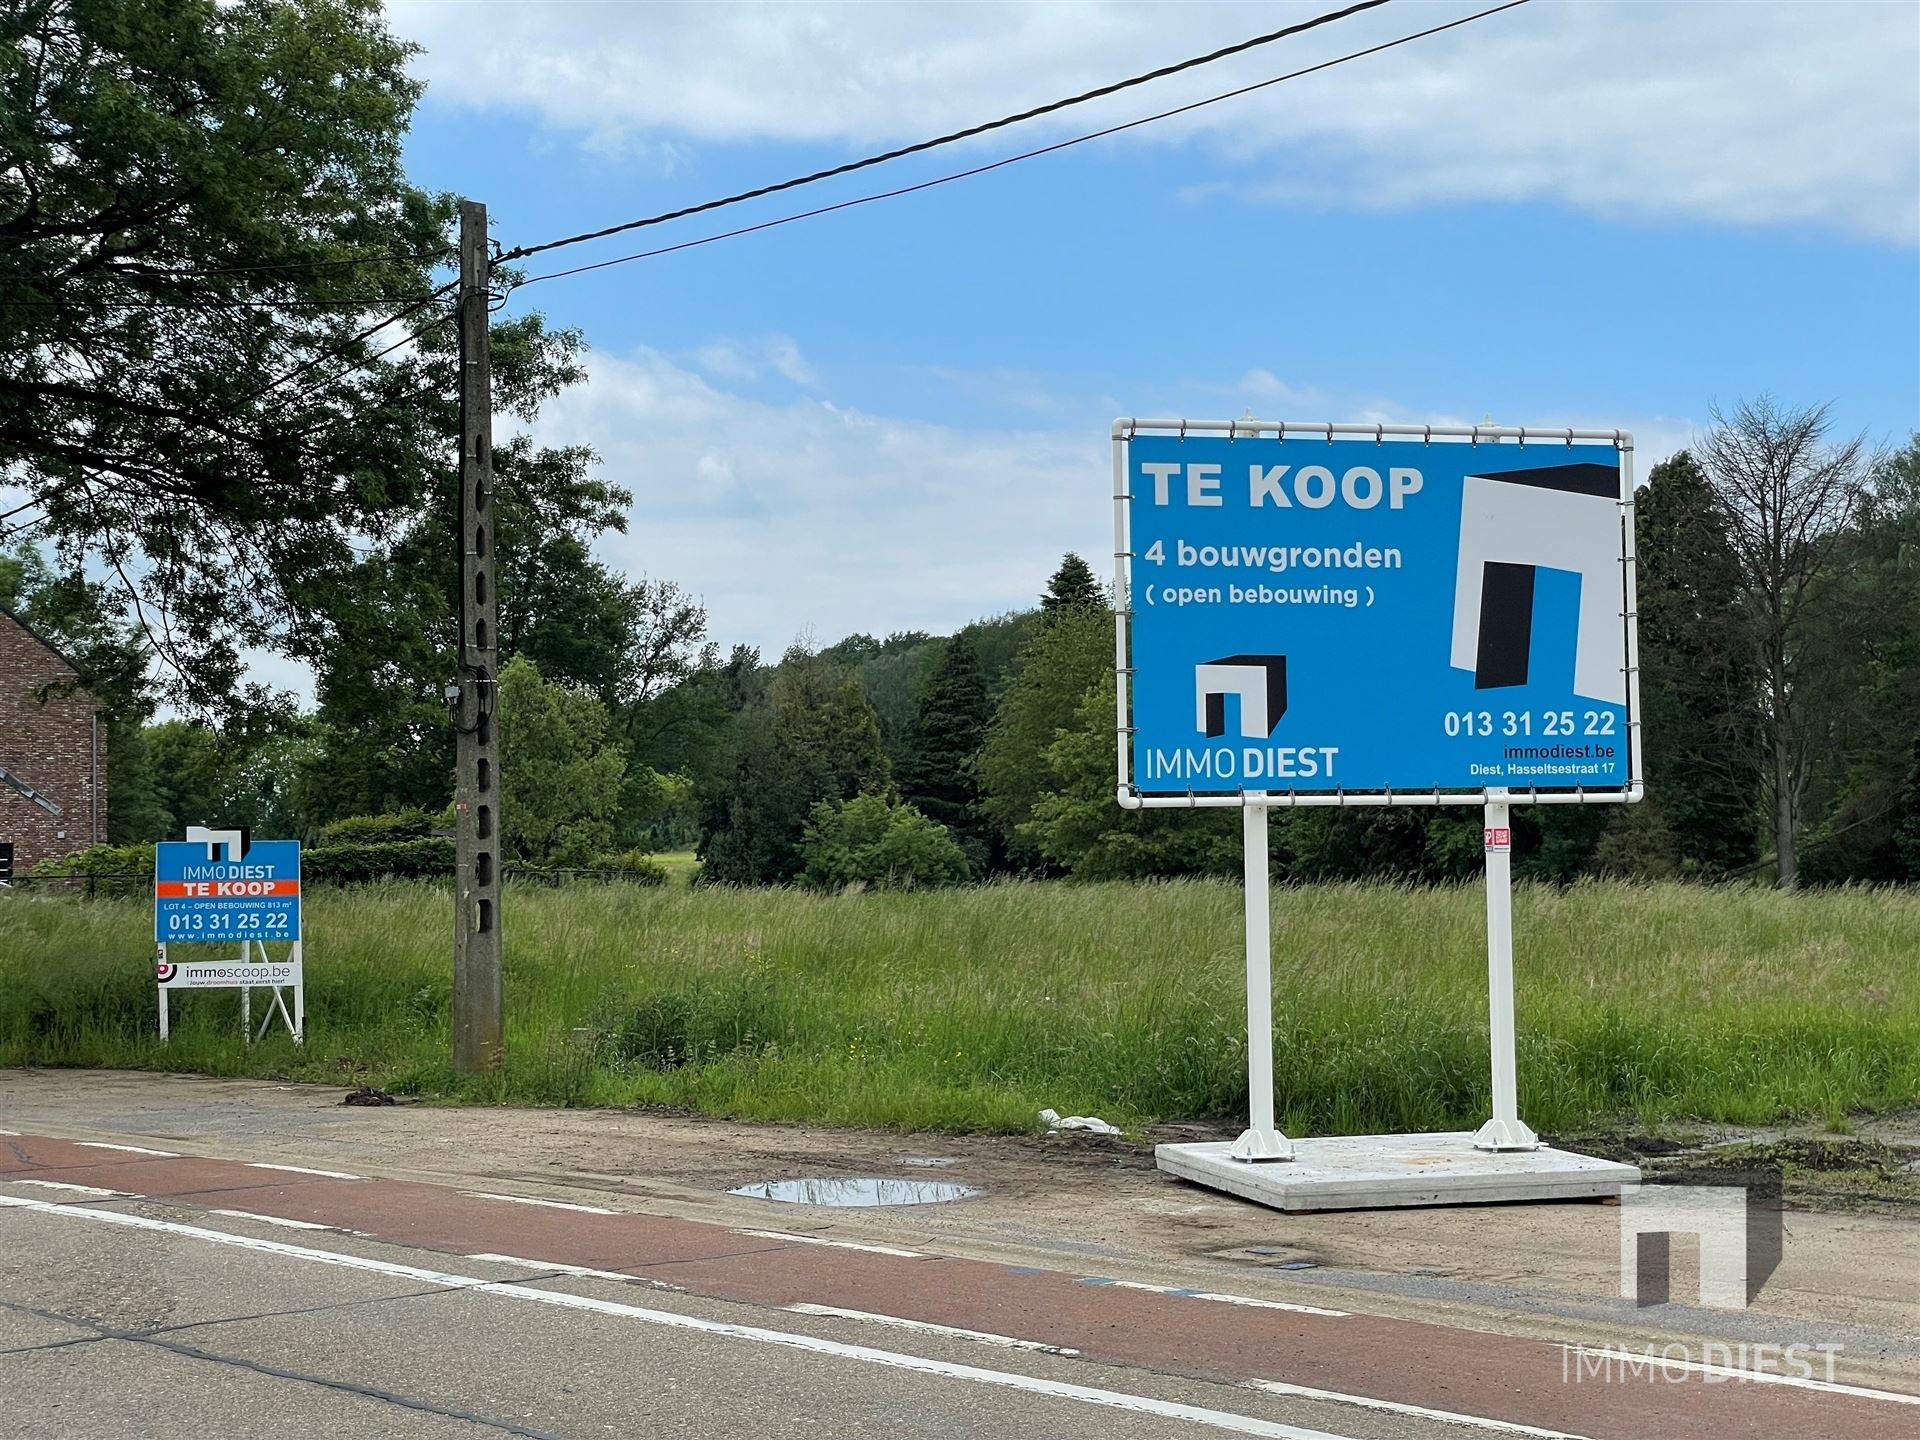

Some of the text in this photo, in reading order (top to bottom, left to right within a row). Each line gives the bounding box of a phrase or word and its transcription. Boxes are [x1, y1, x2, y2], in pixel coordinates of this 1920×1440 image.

[1141, 463, 1424, 510] TE KOOP
[1145, 540, 1402, 573] 4 bouwgronden
[1163, 587, 1222, 606] open
[1229, 584, 1358, 608] bebouwing
[1444, 711, 1615, 736] 013 31 25 22
[1504, 744, 1615, 759] immodiest.be
[1146, 747, 1339, 779] IMMO DIEST
[1470, 763, 1615, 776] Diest, Hasseltsestraat 17
[183, 865, 275, 879] IMMO DIEST
[183, 881, 275, 896] TE KOOP
[193, 902, 216, 910] OPEN
[217, 901, 266, 909] BEBOUWING
[169, 912, 288, 930] 013 31 25 22
[168, 931, 289, 940] www.immodiest.be
[186, 965, 290, 979] immoscoop.be
